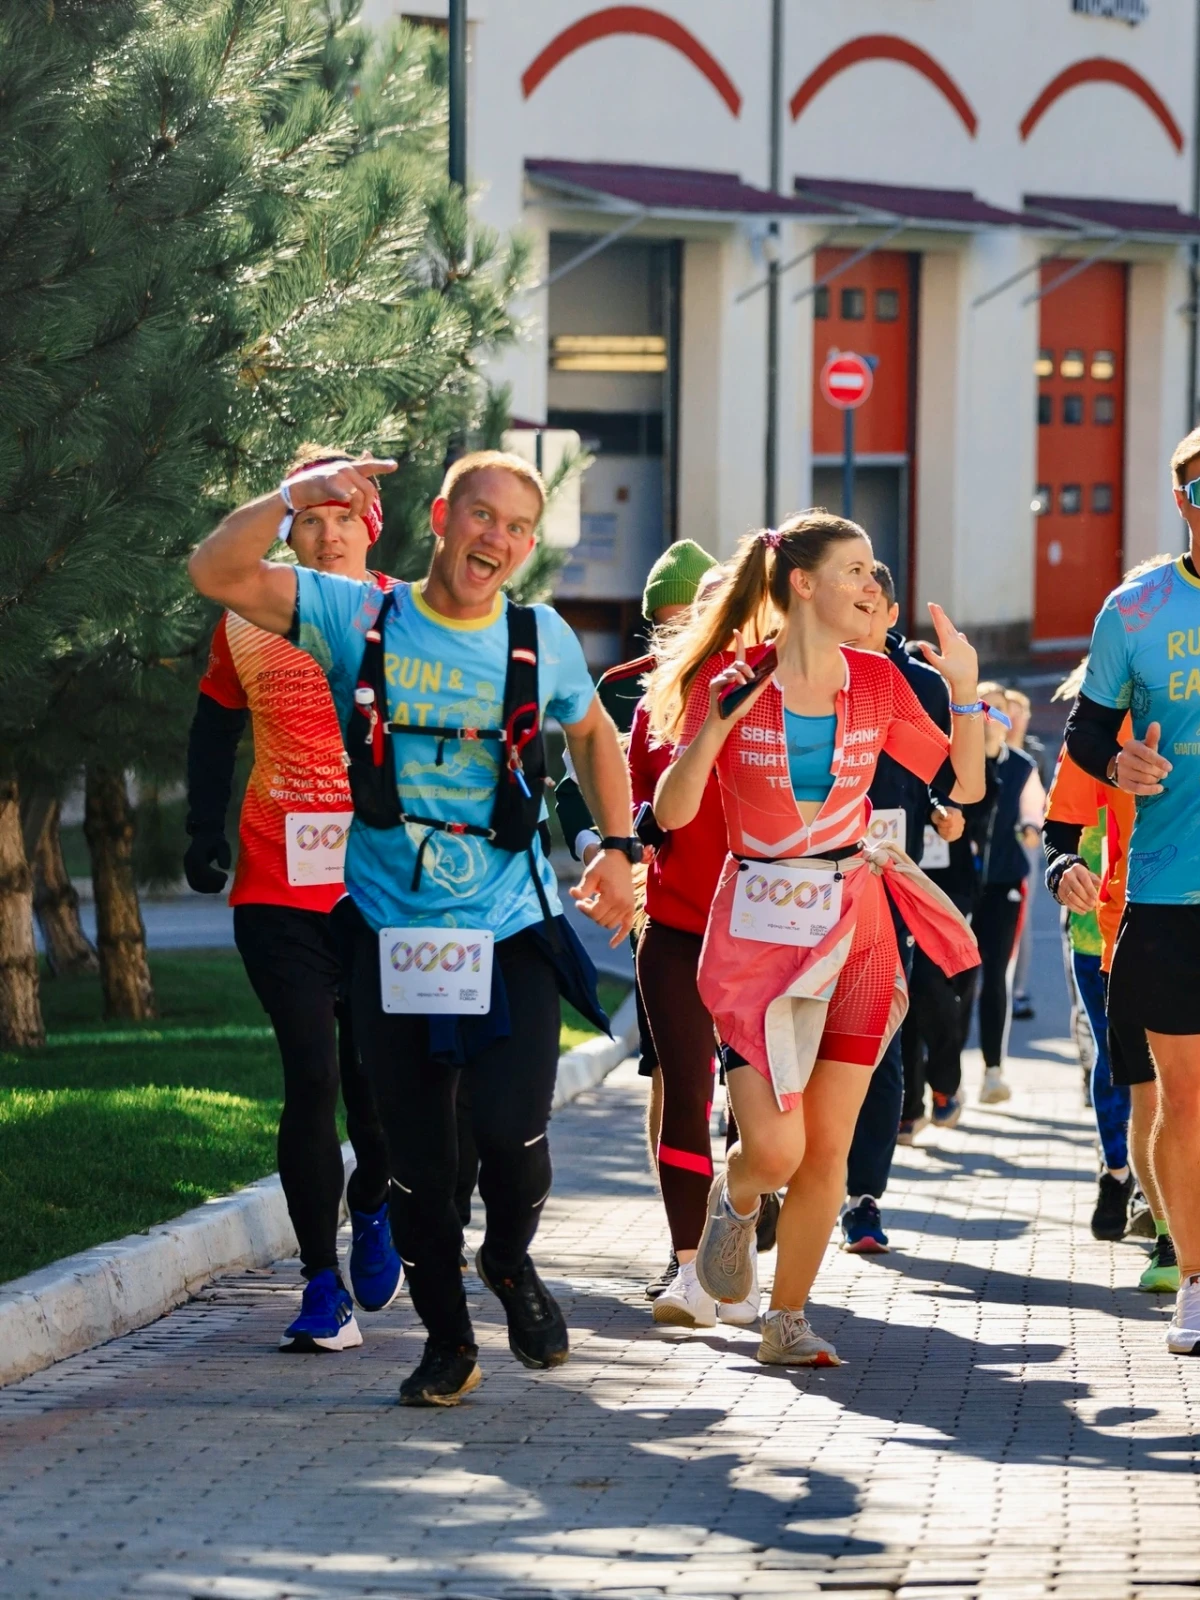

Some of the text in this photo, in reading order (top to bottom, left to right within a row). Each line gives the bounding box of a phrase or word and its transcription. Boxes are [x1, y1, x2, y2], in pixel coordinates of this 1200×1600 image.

[257, 669, 309, 681] ВЯТСКИЕ
[384, 652, 464, 694] RUN &
[259, 681, 309, 693] ВЯТСКИЕ
[387, 699, 434, 727] AT
[269, 789, 316, 803] ВЯТСКИЕ
[296, 824, 350, 851] 00
[864, 819, 898, 839] 01
[745, 874, 833, 911] 0001
[390, 941, 482, 973] 0001
